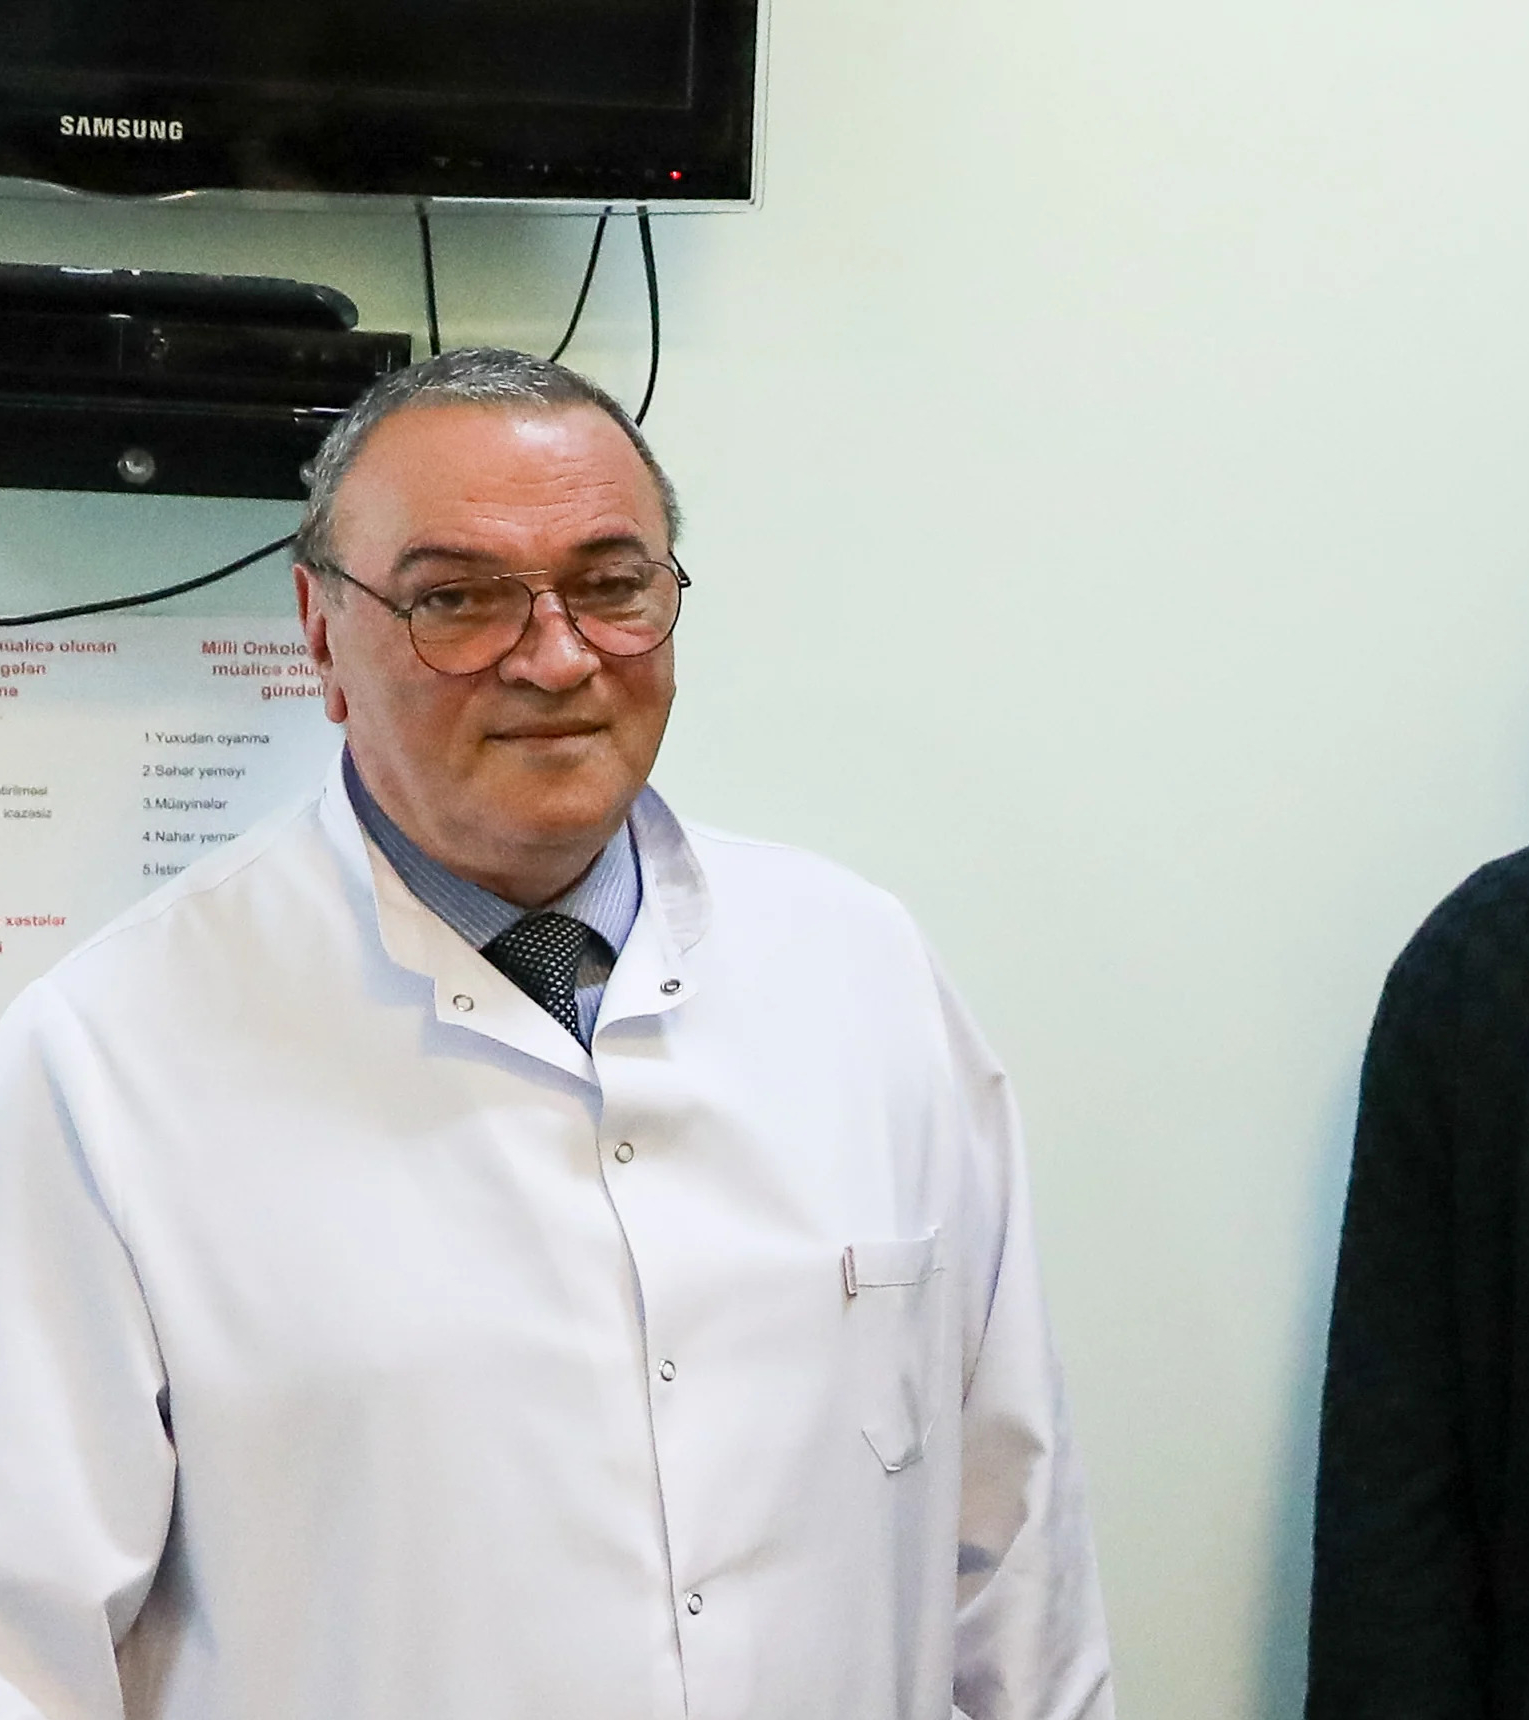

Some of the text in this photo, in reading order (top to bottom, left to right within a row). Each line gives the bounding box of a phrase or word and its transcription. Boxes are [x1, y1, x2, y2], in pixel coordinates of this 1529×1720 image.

[60, 115, 183, 140] SAMSUNG
[60, 640, 117, 653] olunan
[201, 641, 307, 655] Milli Onkolo
[287, 663, 315, 676] olu
[261, 685, 323, 700] gündəl
[199, 833, 240, 844] yemə
